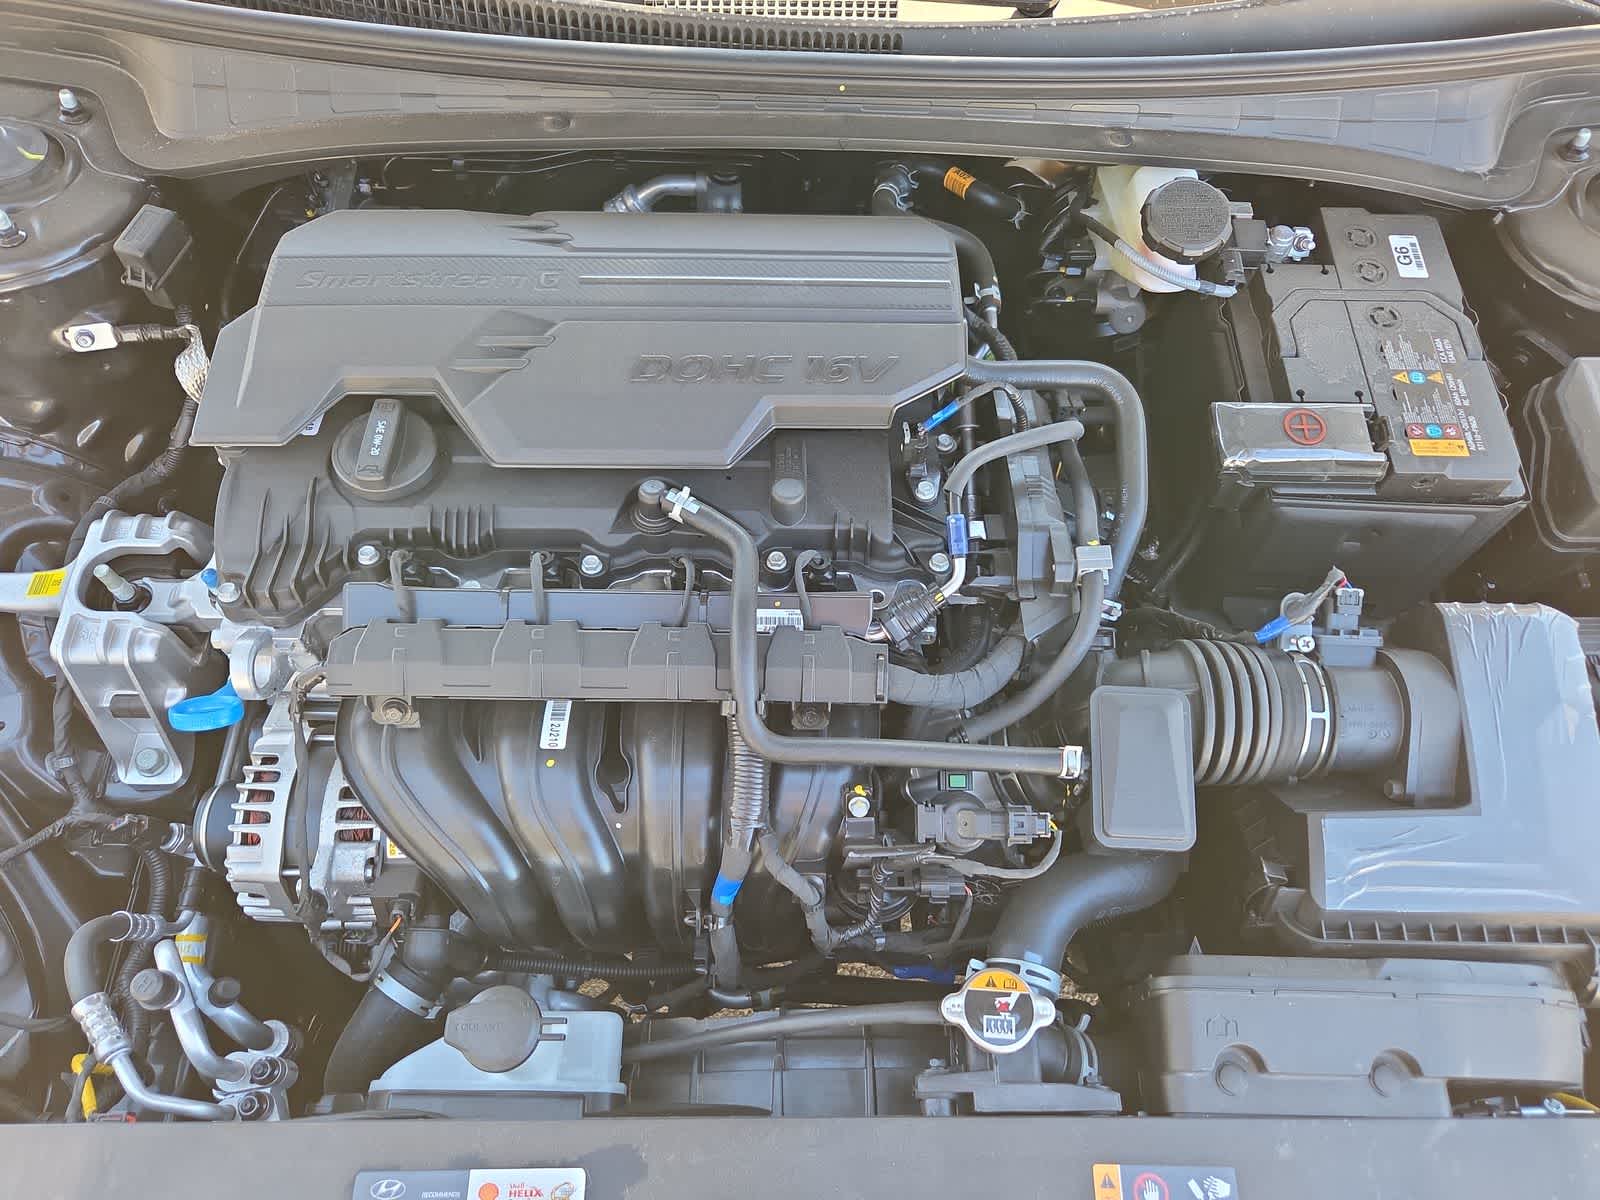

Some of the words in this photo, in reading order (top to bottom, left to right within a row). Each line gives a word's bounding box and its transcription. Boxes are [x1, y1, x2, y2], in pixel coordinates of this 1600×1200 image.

[1394, 246, 1413, 265] G6
[629, 354, 793, 384] DOHC
[806, 355, 899, 384] 16V
[375, 420, 387, 434] SAE
[370, 434, 384, 456] 0W-20
[547, 723, 560, 748] 2J210
[507, 1189, 544, 1198] HELIX
